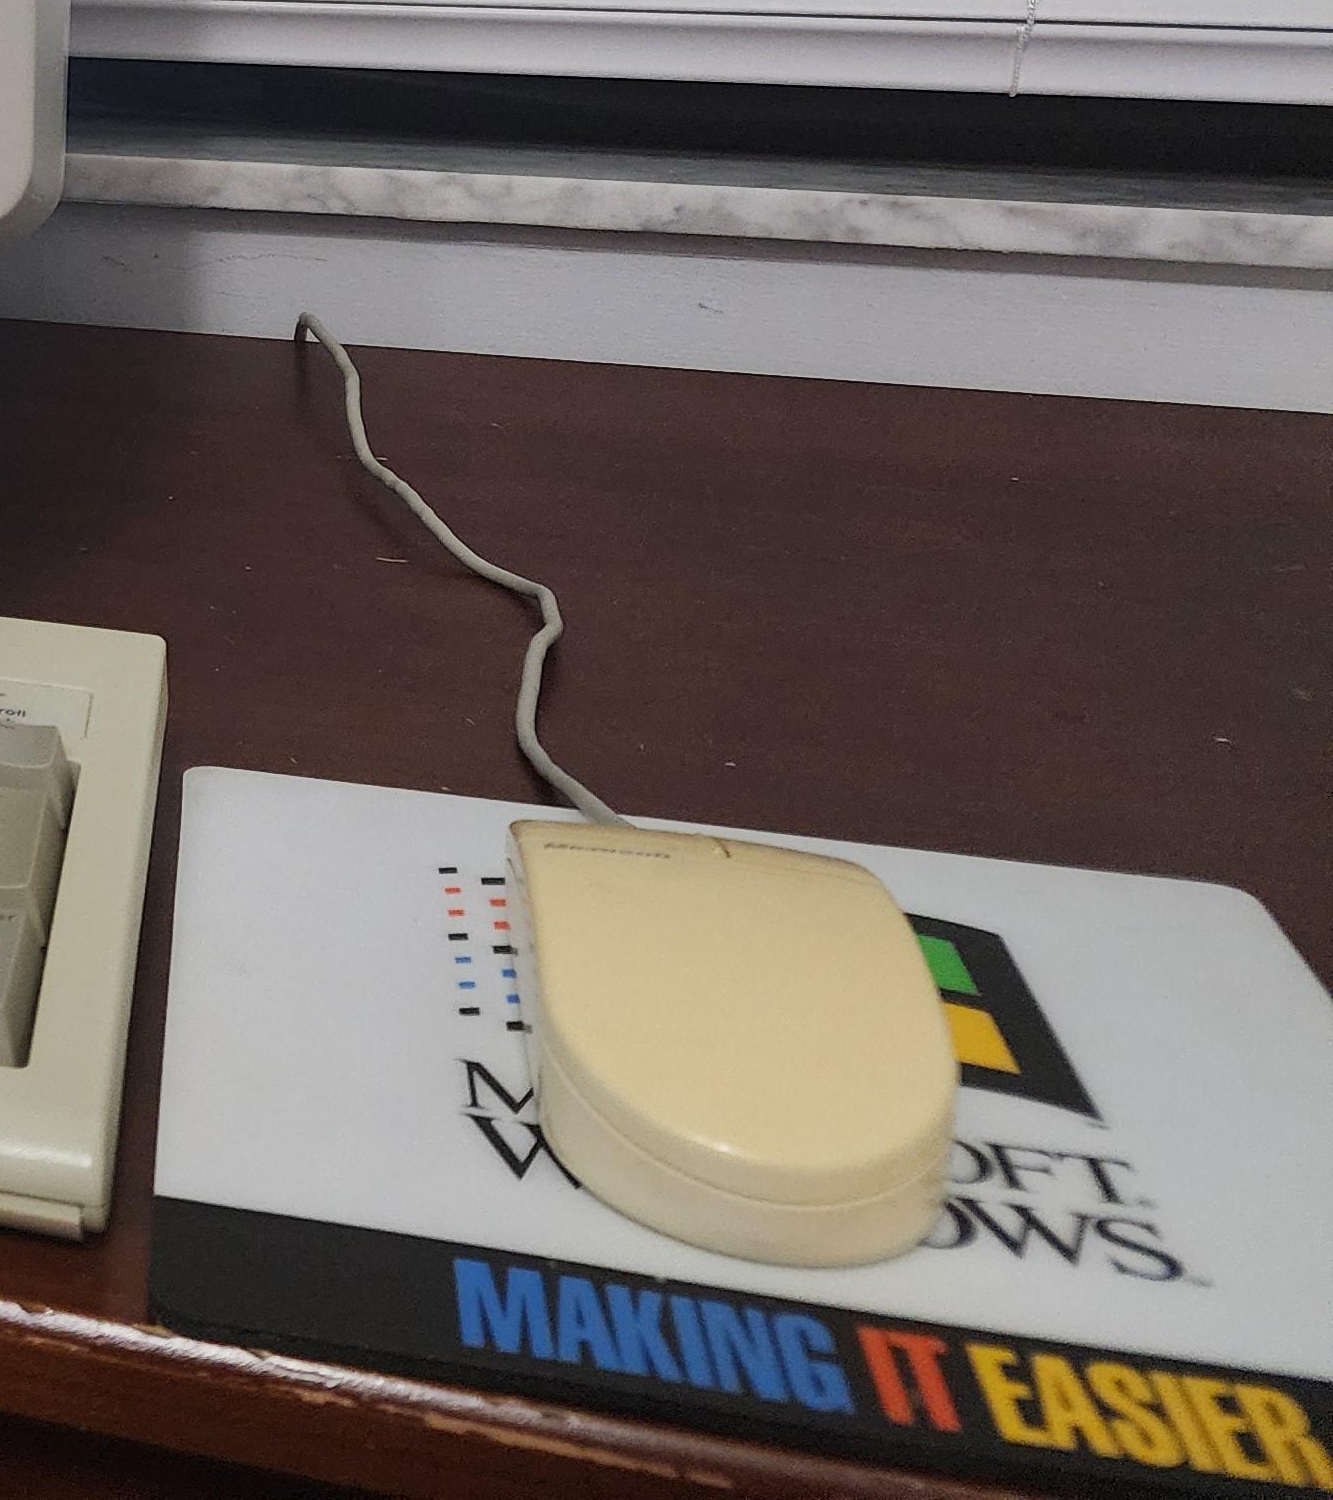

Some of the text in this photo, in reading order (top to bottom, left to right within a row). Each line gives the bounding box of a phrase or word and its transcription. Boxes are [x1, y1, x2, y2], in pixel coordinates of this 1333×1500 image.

[452, 1257, 1333, 1490] MAKING IT EASIER
